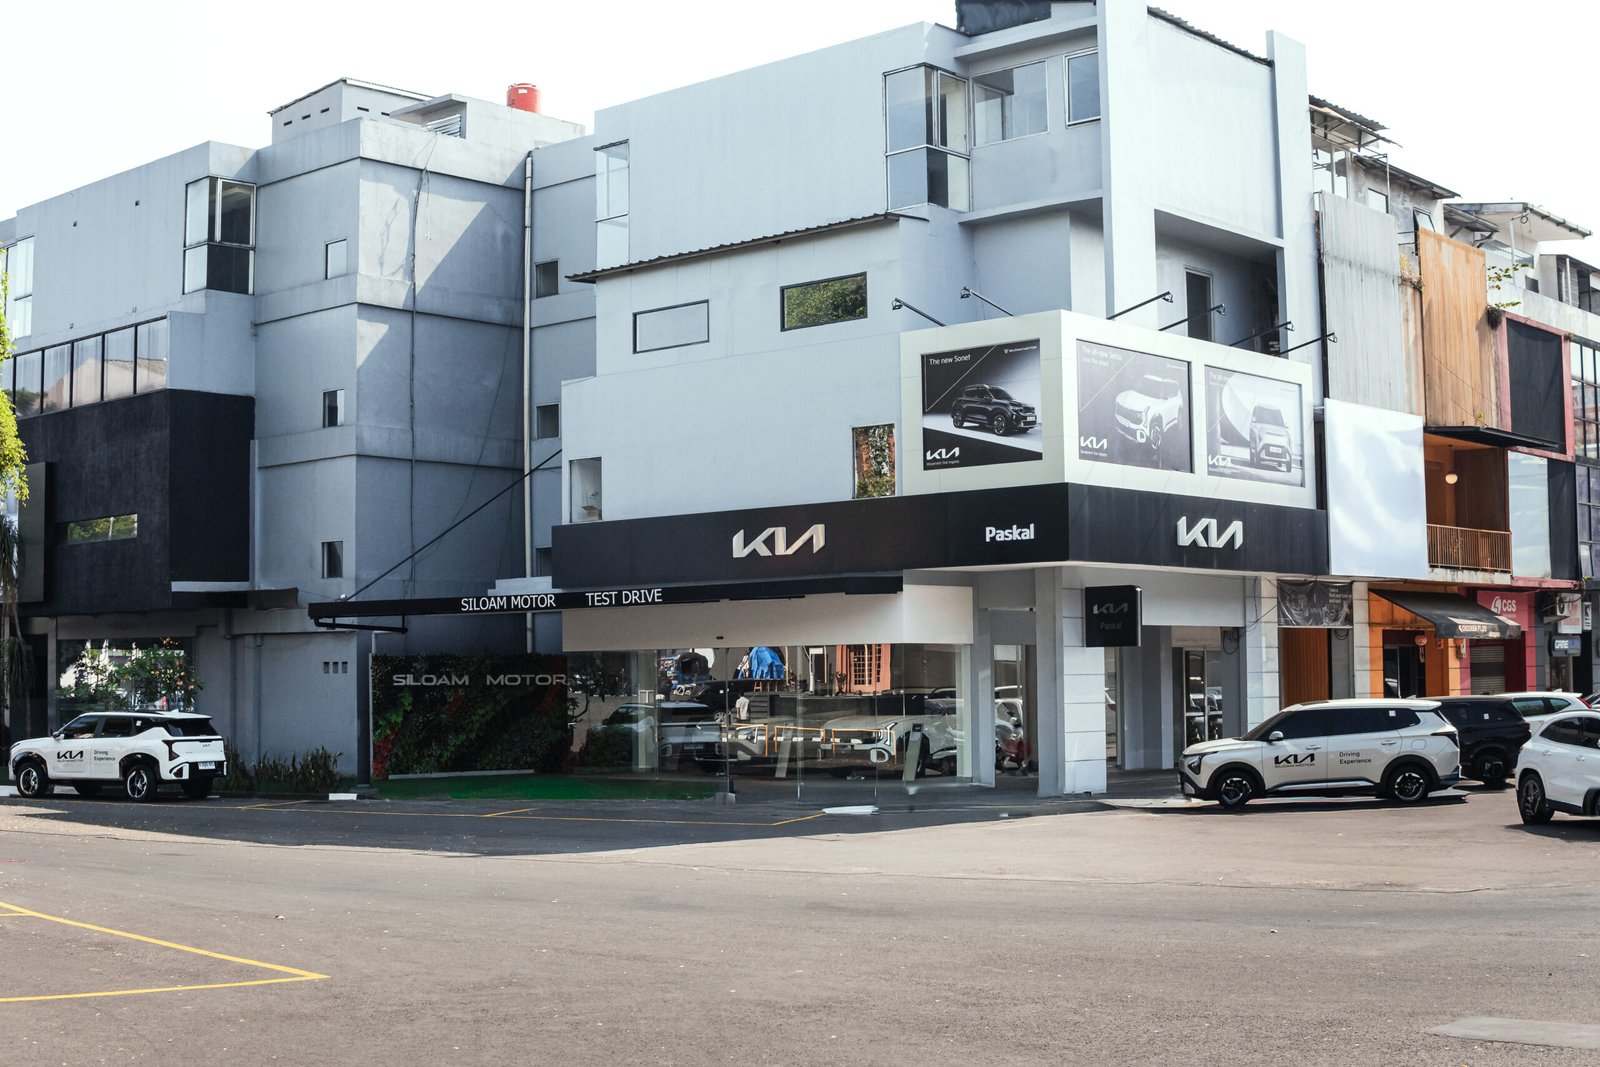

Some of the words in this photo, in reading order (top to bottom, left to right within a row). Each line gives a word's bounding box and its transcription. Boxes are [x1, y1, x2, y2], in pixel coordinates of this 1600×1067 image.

[954, 354, 971, 363] Sonet
[1080, 435, 1108, 450] KIA
[926, 447, 960, 460] KIA
[985, 523, 1035, 542] Paskal
[1176, 516, 1244, 550] KIA
[732, 523, 826, 558] KIA
[460, 597, 507, 611] SILOAM
[511, 594, 556, 609] MOTOR
[585, 591, 619, 606] TEST
[622, 589, 663, 604] DRIVE
[1093, 603, 1128, 614] KIA
[1501, 599, 1517, 612] CGS
[392, 674, 469, 686] SILOAM
[486, 674, 568, 686] MOTOR
[56, 750, 84, 760] KIA
[1274, 753, 1315, 764] KIA
